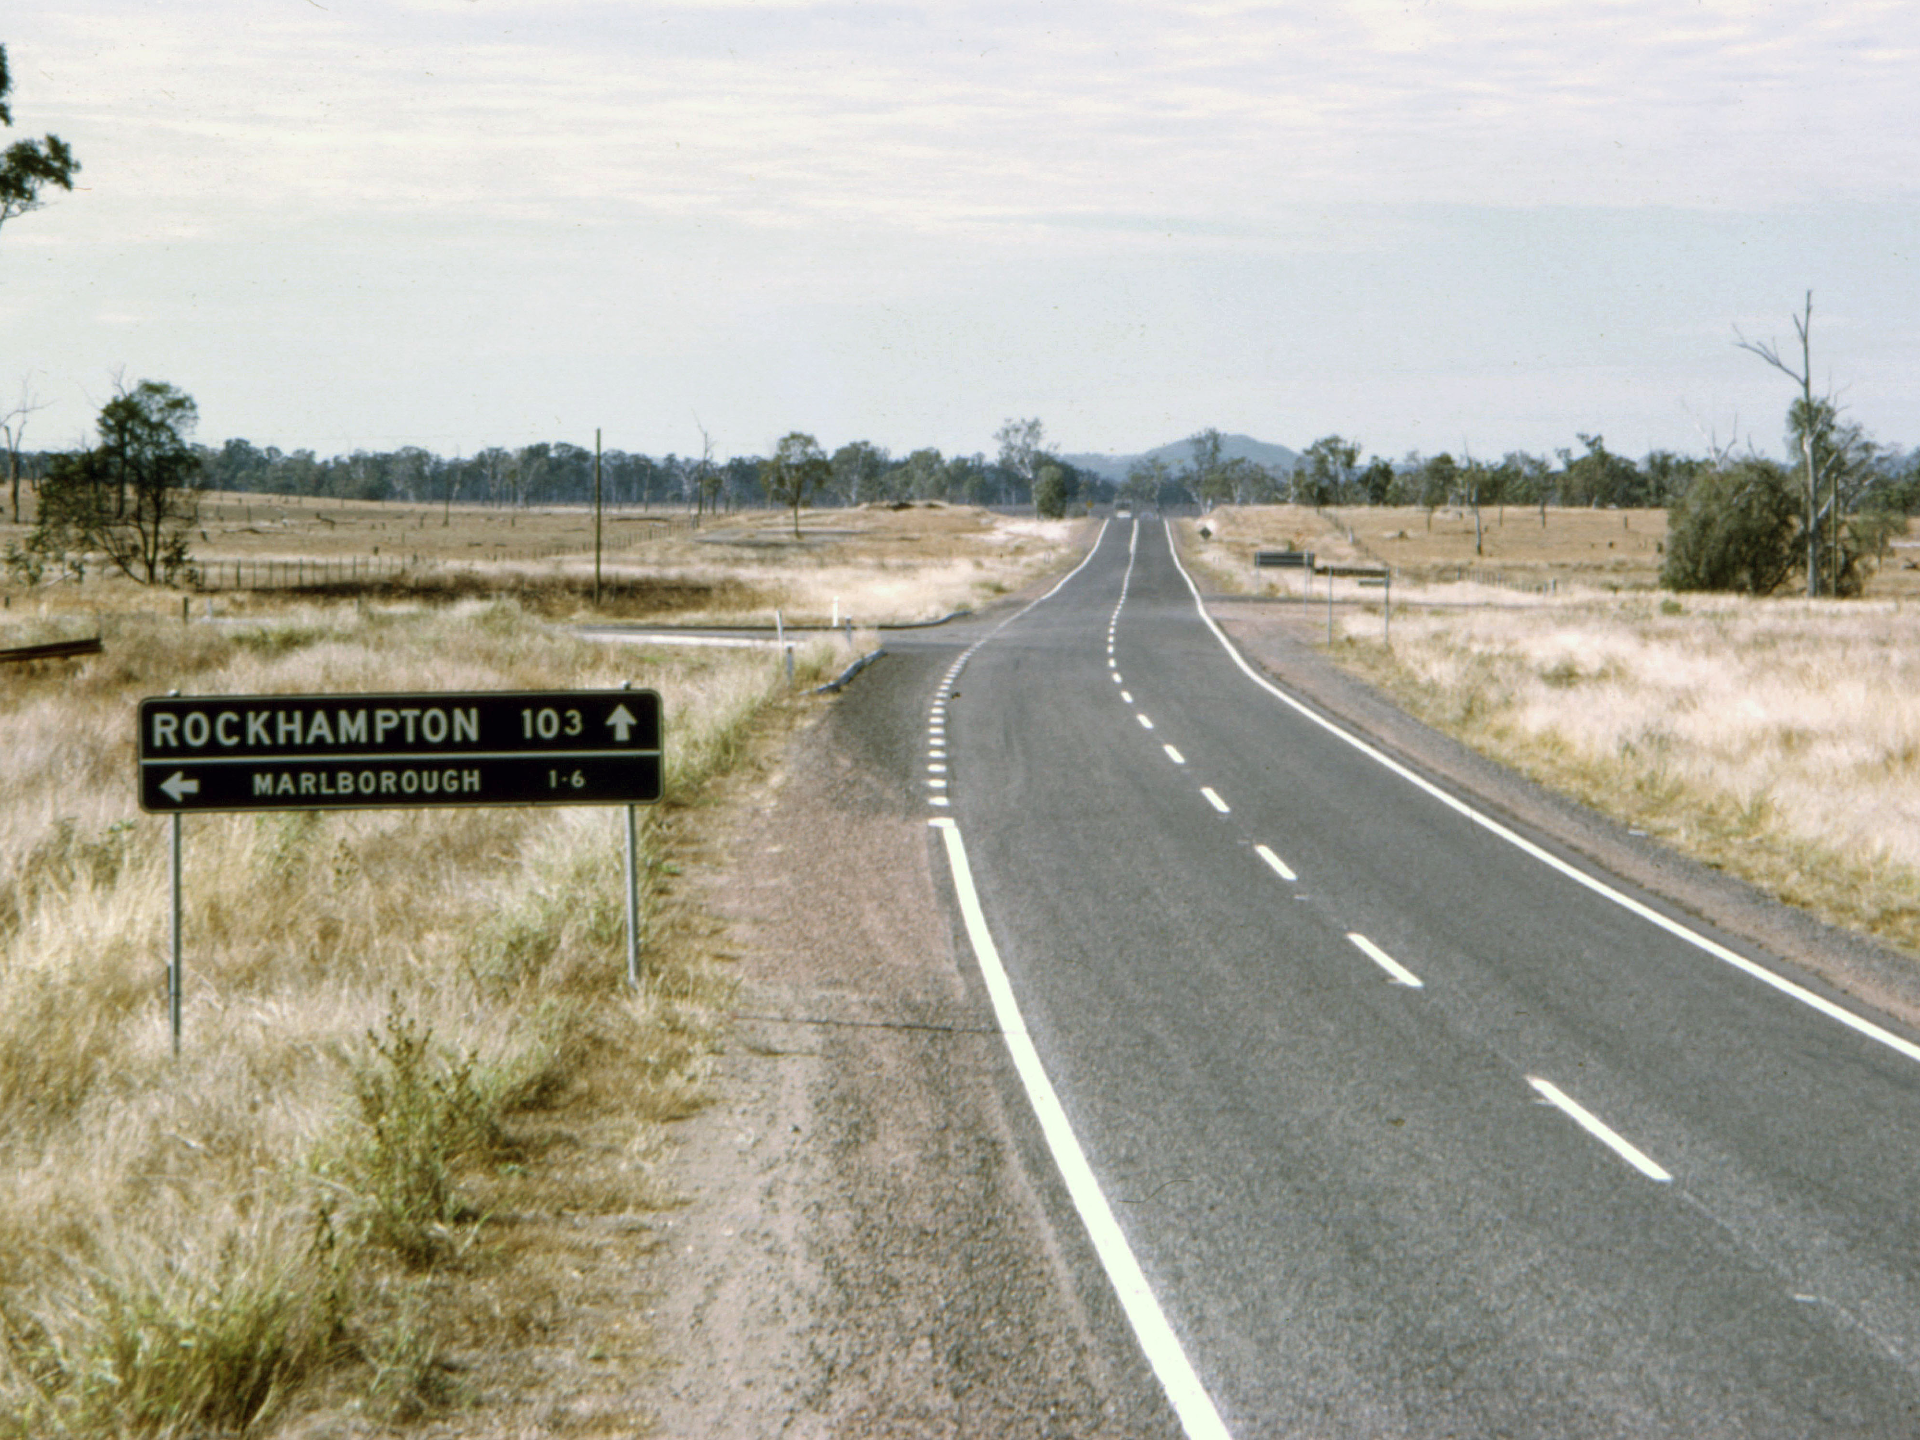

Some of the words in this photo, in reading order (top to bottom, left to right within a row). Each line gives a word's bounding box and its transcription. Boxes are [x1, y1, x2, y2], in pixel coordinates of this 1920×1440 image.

[153, 707, 479, 747] ROCKHAMPTON
[522, 708, 582, 739] 103
[253, 769, 480, 795] MARLBOROUGH
